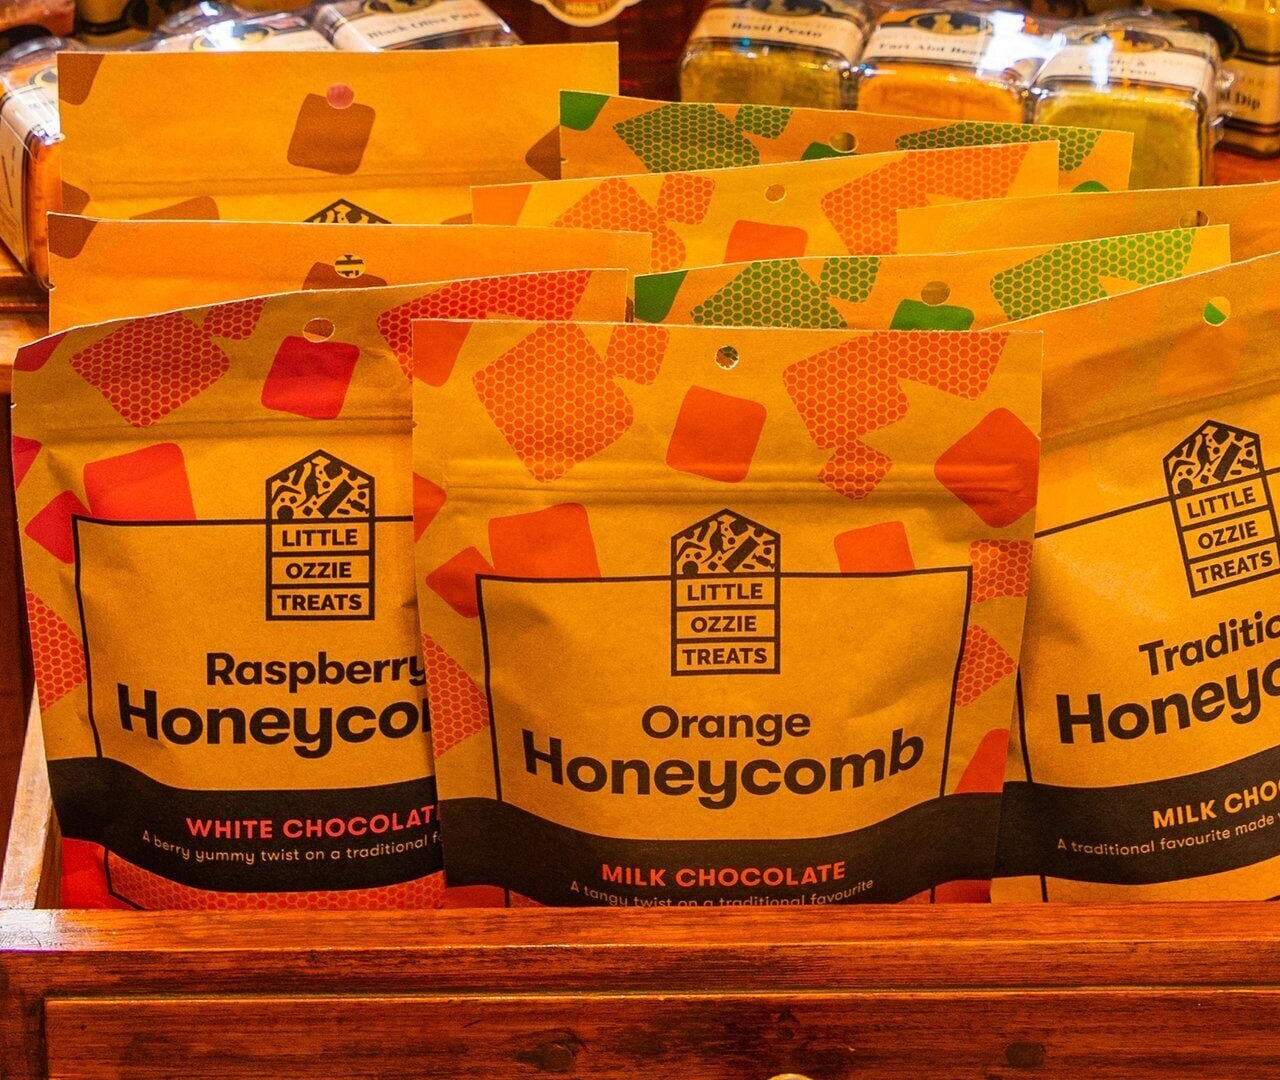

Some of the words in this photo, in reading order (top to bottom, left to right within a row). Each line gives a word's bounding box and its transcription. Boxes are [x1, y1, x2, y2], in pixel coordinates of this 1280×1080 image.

[1186, 486, 1257, 519] LITTLE
[281, 528, 358, 547] LITTLE
[1197, 520, 1259, 550] OZZIE
[285, 561, 352, 579] OZZIE
[1195, 550, 1273, 585] TREATS
[277, 593, 363, 612] TREATS
[686, 583, 763, 601] LITTLE
[690, 615, 758, 633] OZZIE
[682, 647, 768, 666] TREATS
[641, 704, 811, 747] Orange
[521, 727, 925, 810] Honeycomb
[185, 818, 273, 839] WHITE
[282, 805, 435, 839] CHOCOLAT
[1152, 799, 1218, 830] MILK
[142, 830, 151, 842] A
[154, 834, 190, 860] berry
[195, 849, 254, 865] yummy
[261, 848, 299, 862] twist
[305, 849, 325, 861] on
[330, 849, 340, 860] a
[346, 833, 429, 860] traditional
[1057, 838, 1067, 851] A
[1071, 839, 1155, 856] traditional
[1160, 828, 1231, 851] favourite
[1234, 813, 1275, 837] made
[601, 863, 666, 887] MILK
[674, 861, 846, 888] CHOCOLATE
[570, 880, 580, 893] A
[583, 885, 626, 906] tangy
[633, 896, 672, 907] twist
[677, 898, 698, 907] on
[719, 894, 806, 907] traditional
[810, 879, 875, 907] favourite
